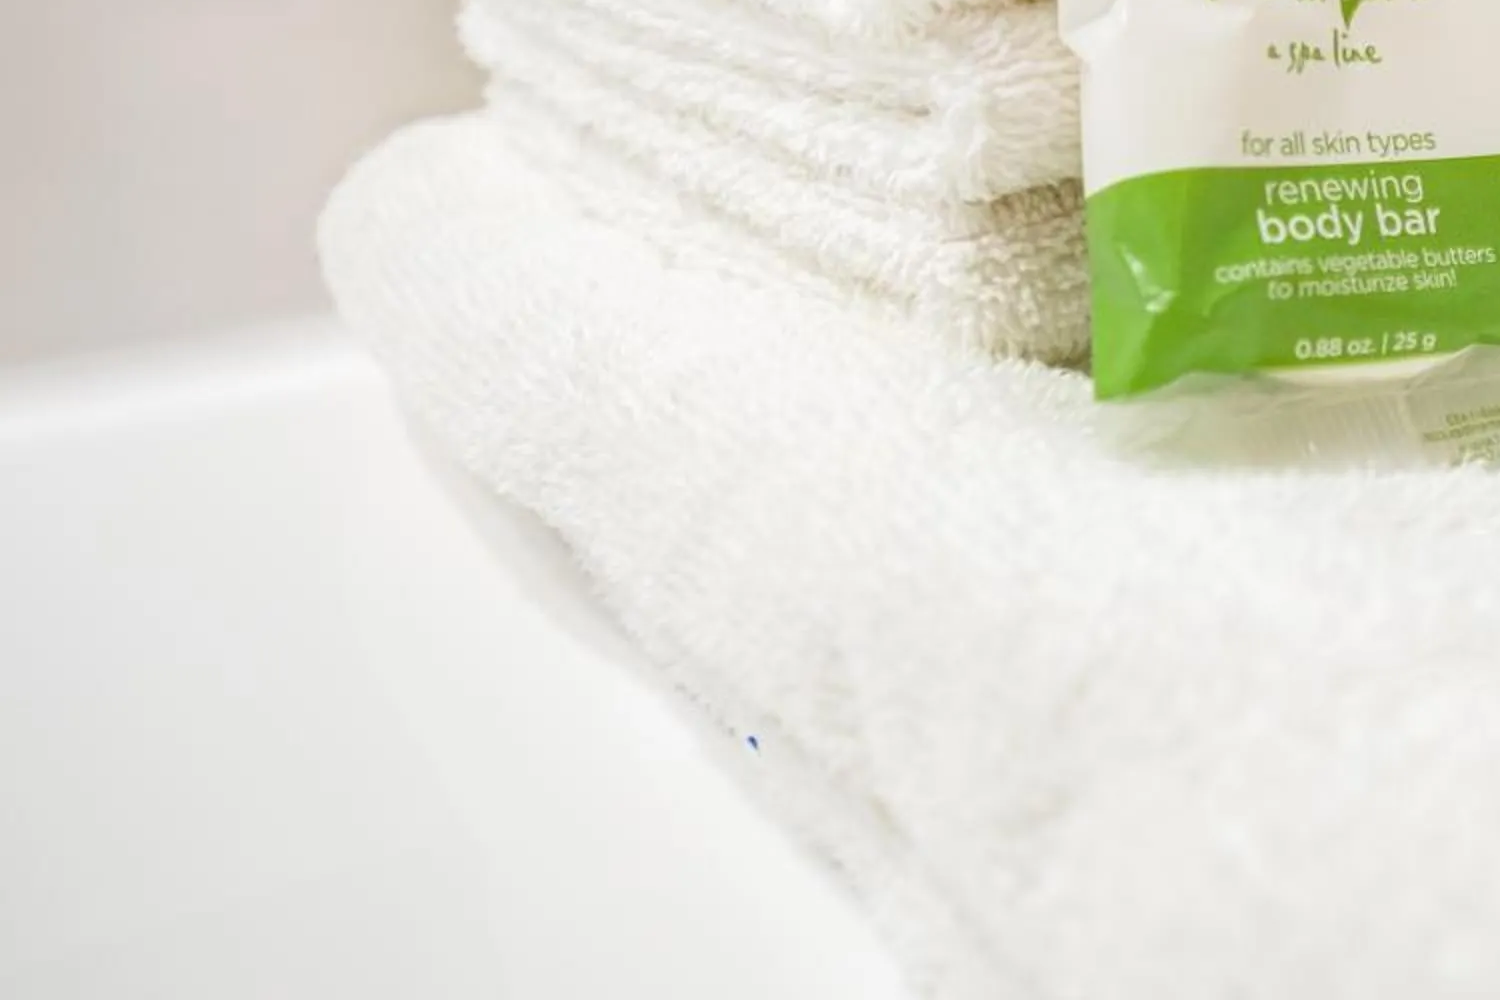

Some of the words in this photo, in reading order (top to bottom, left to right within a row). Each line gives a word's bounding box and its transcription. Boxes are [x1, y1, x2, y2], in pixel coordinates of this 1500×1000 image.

[1333, 28, 1382, 68] line
[1242, 131, 1273, 157] for
[1280, 131, 1305, 155] all
[1313, 131, 1361, 155] skin
[1368, 131, 1436, 157] types
[1265, 170, 1424, 204] renewing
[1256, 204, 1364, 245] body
[1375, 204, 1441, 237] bar
[1214, 254, 1314, 283] contains
[1318, 250, 1419, 276] vegetable
[1421, 246, 1497, 267] butters
[1267, 279, 1293, 300] to
[1414, 269, 1457, 291] skin!
[1295, 337, 1343, 360] 0.88
[1392, 330, 1417, 350] 25
